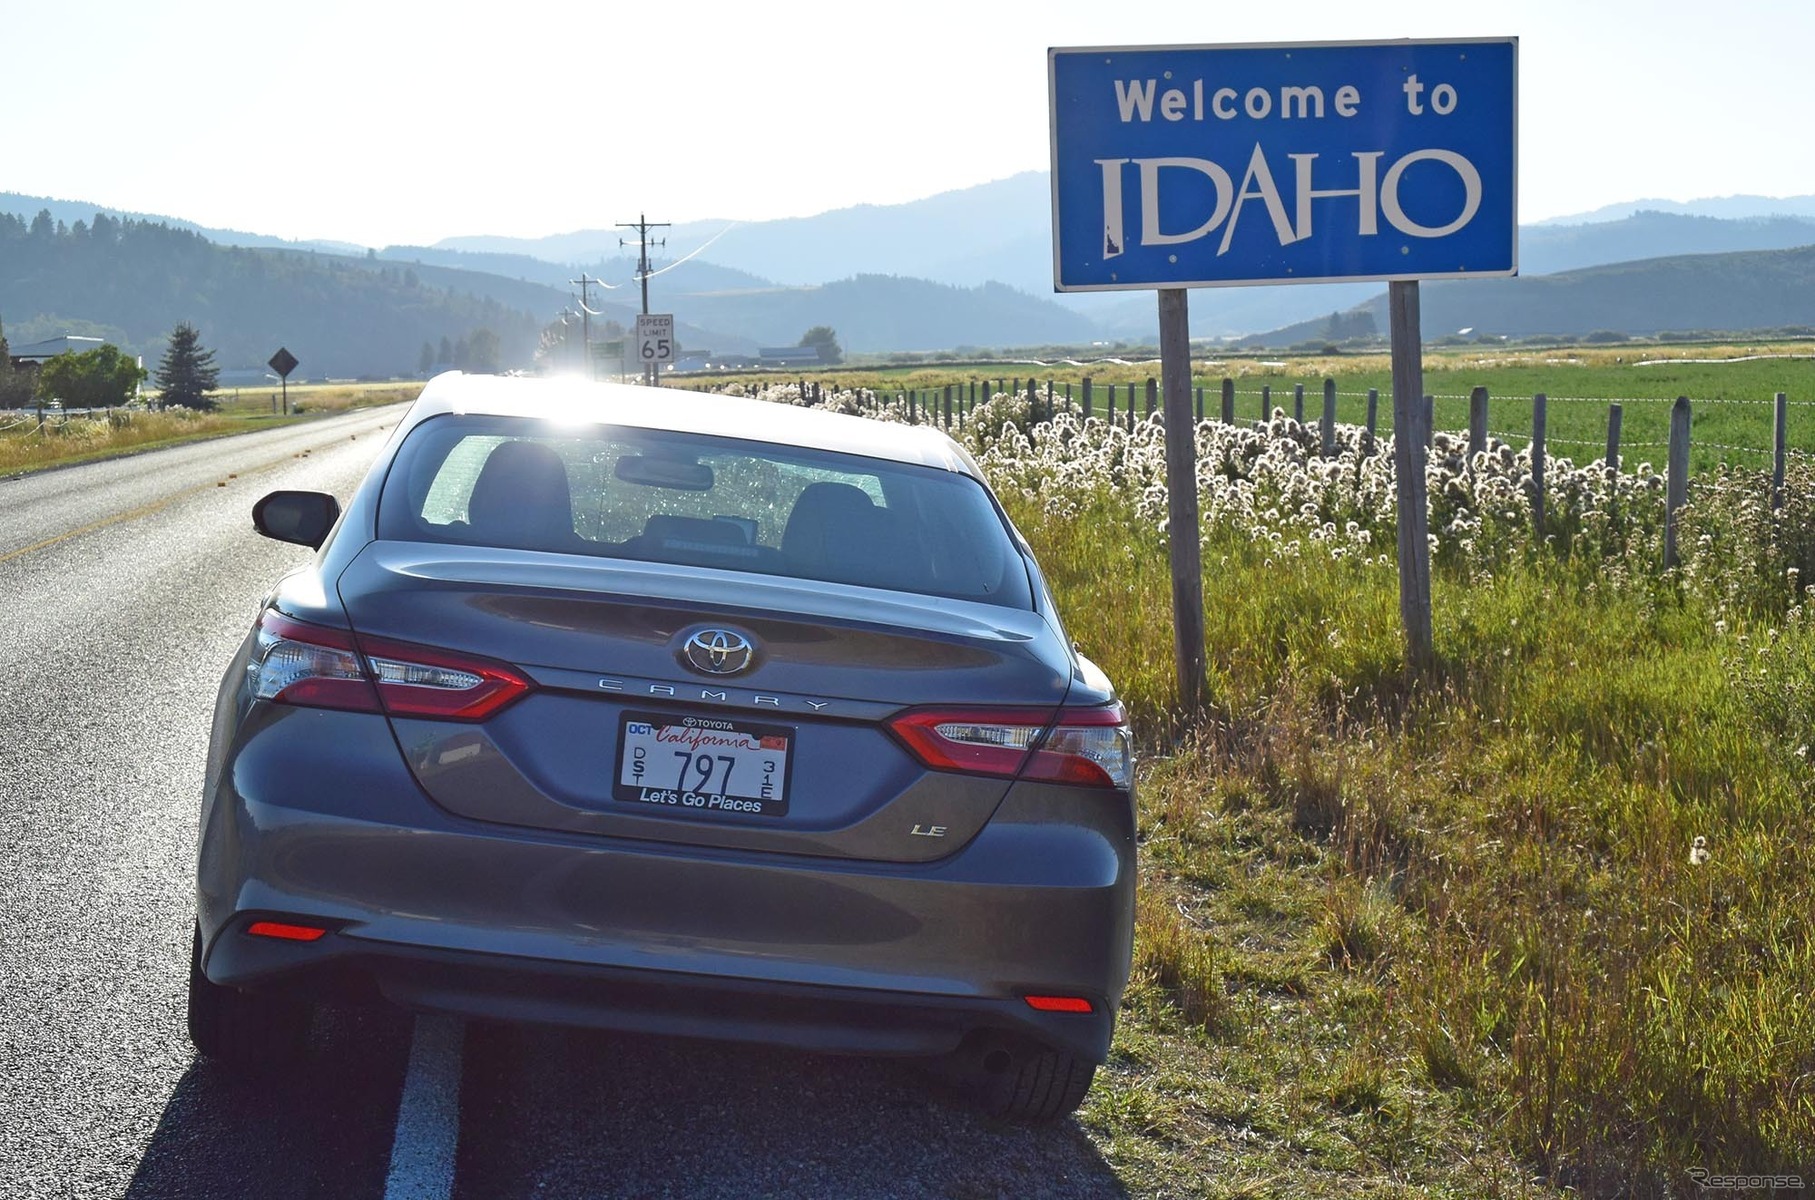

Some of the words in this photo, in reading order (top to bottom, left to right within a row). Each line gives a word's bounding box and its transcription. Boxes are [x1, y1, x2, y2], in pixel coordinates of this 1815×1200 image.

[1113, 78, 1361, 123] Welcome
[1402, 74, 1458, 116] to
[1093, 141, 1483, 261] IDAHO
[640, 318, 670, 327] SPEED
[643, 328, 667, 337] LIMIT
[641, 340, 670, 359] 65
[598, 678, 829, 711] CAMRY
[628, 723, 652, 736] OCT
[697, 719, 734, 731] TOYOTA
[656, 725, 760, 751] California
[674, 751, 736, 795] 797
[639, 787, 678, 806] Let's
[682, 792, 705, 808] Go
[708, 793, 763, 813] Places
[910, 824, 948, 837] LE
